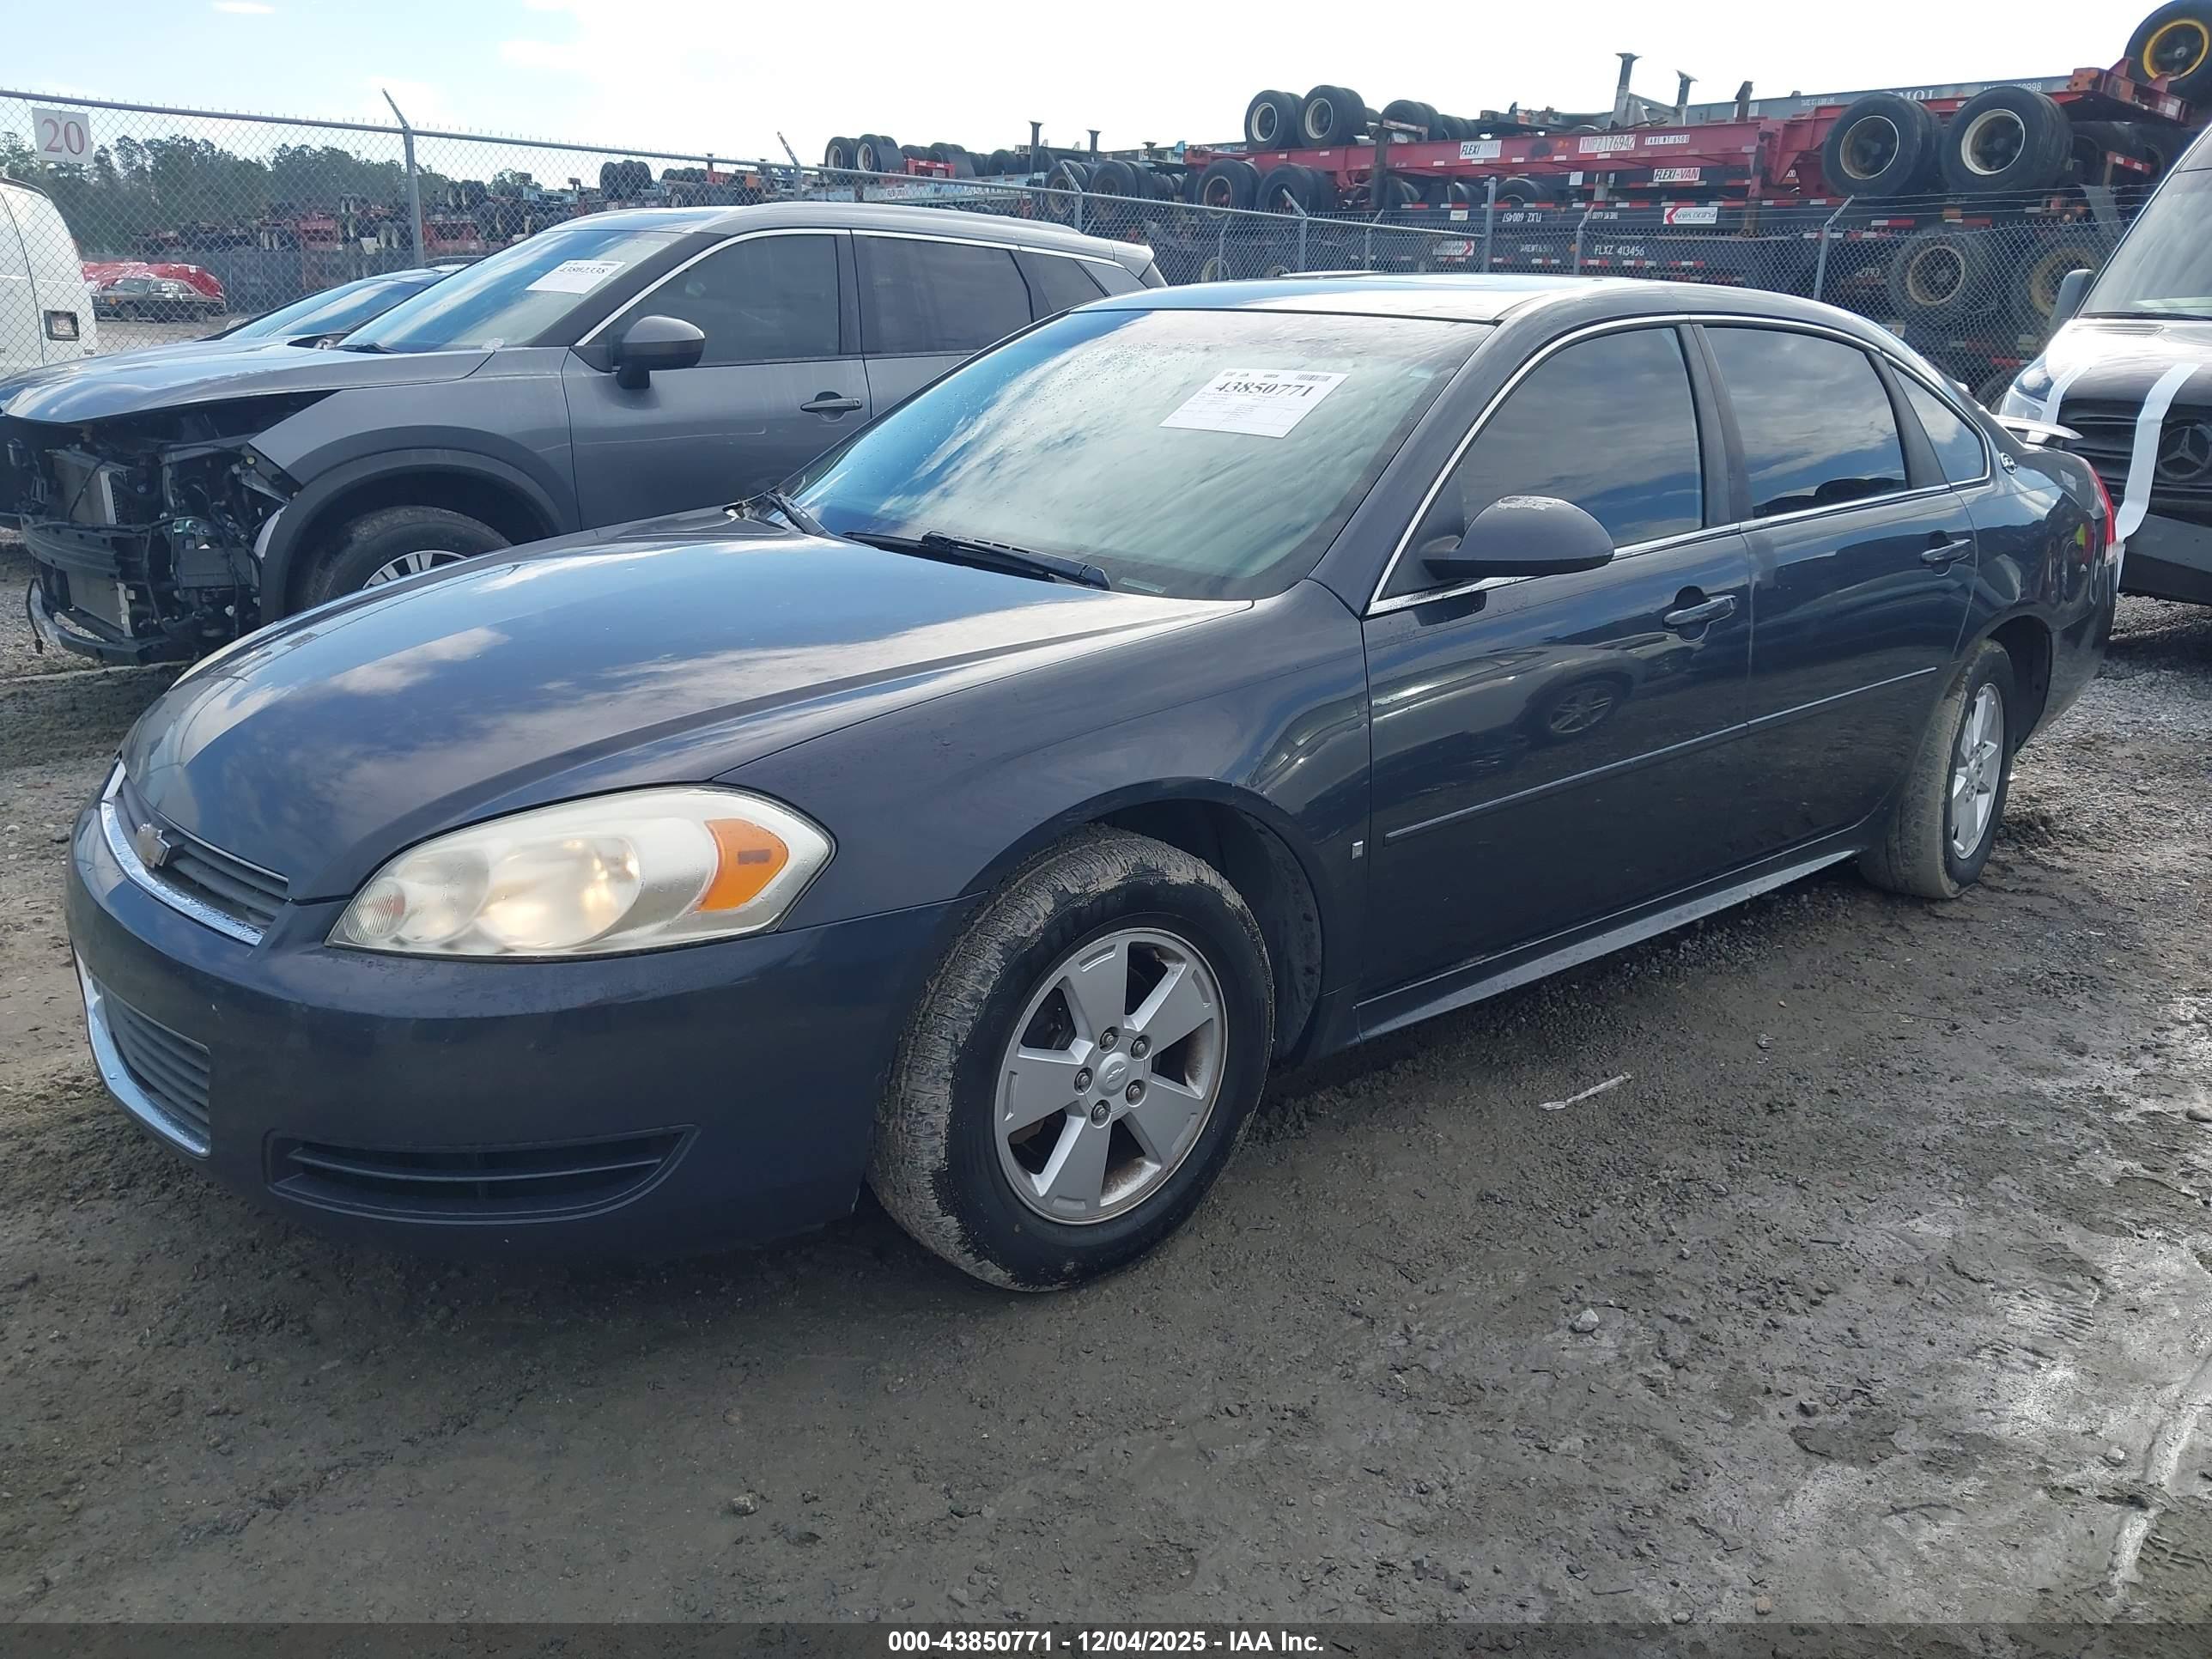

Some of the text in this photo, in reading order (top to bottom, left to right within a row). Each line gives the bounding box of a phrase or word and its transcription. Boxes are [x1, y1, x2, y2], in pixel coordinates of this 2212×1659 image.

[42, 118, 85, 155] 20
[1654, 168, 1699, 180] FLEXI-VAN
[1215, 380, 1316, 398] 43850771
